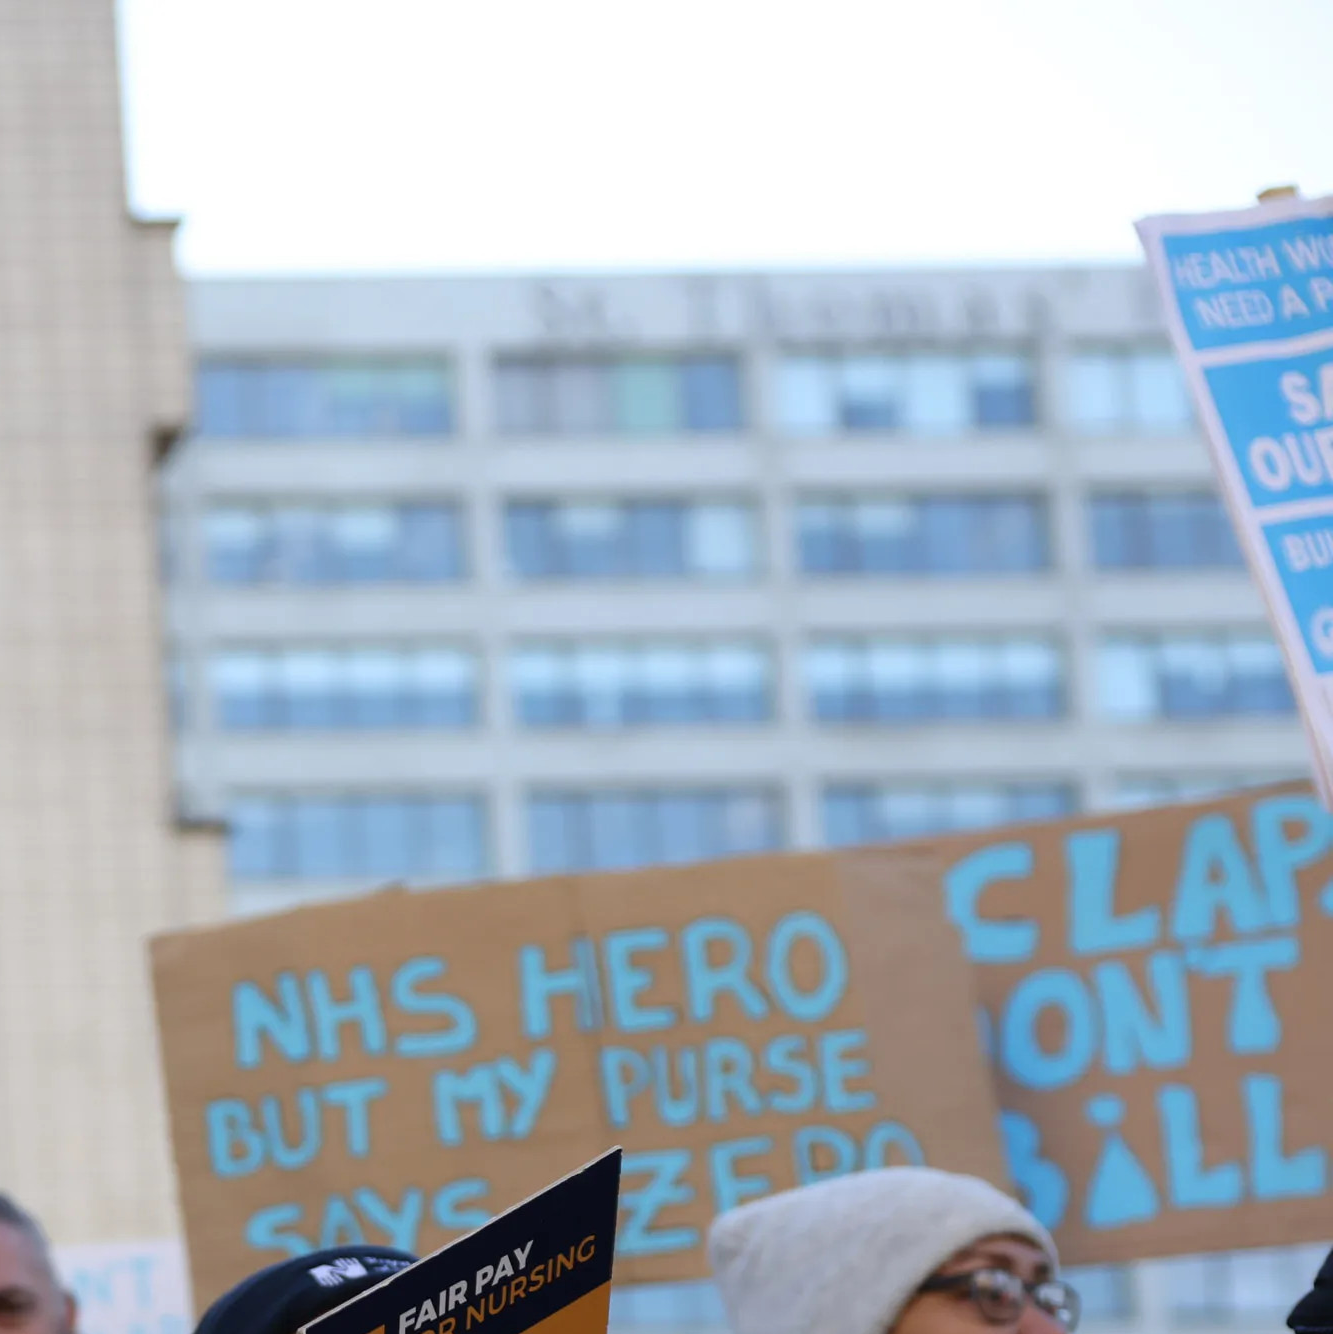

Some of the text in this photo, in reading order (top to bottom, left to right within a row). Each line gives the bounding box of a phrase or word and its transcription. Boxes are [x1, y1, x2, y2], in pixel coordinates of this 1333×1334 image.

[1174, 243, 1282, 289] HEALTH
[1194, 288, 1275, 330] NEED
[1278, 283, 1311, 321] A
[232, 910, 849, 1070] NHS HERO
[205, 1028, 877, 1178] BUT MY PURSE
[466, 1234, 596, 1330] NURSING
[475, 1239, 533, 1296] PAY
